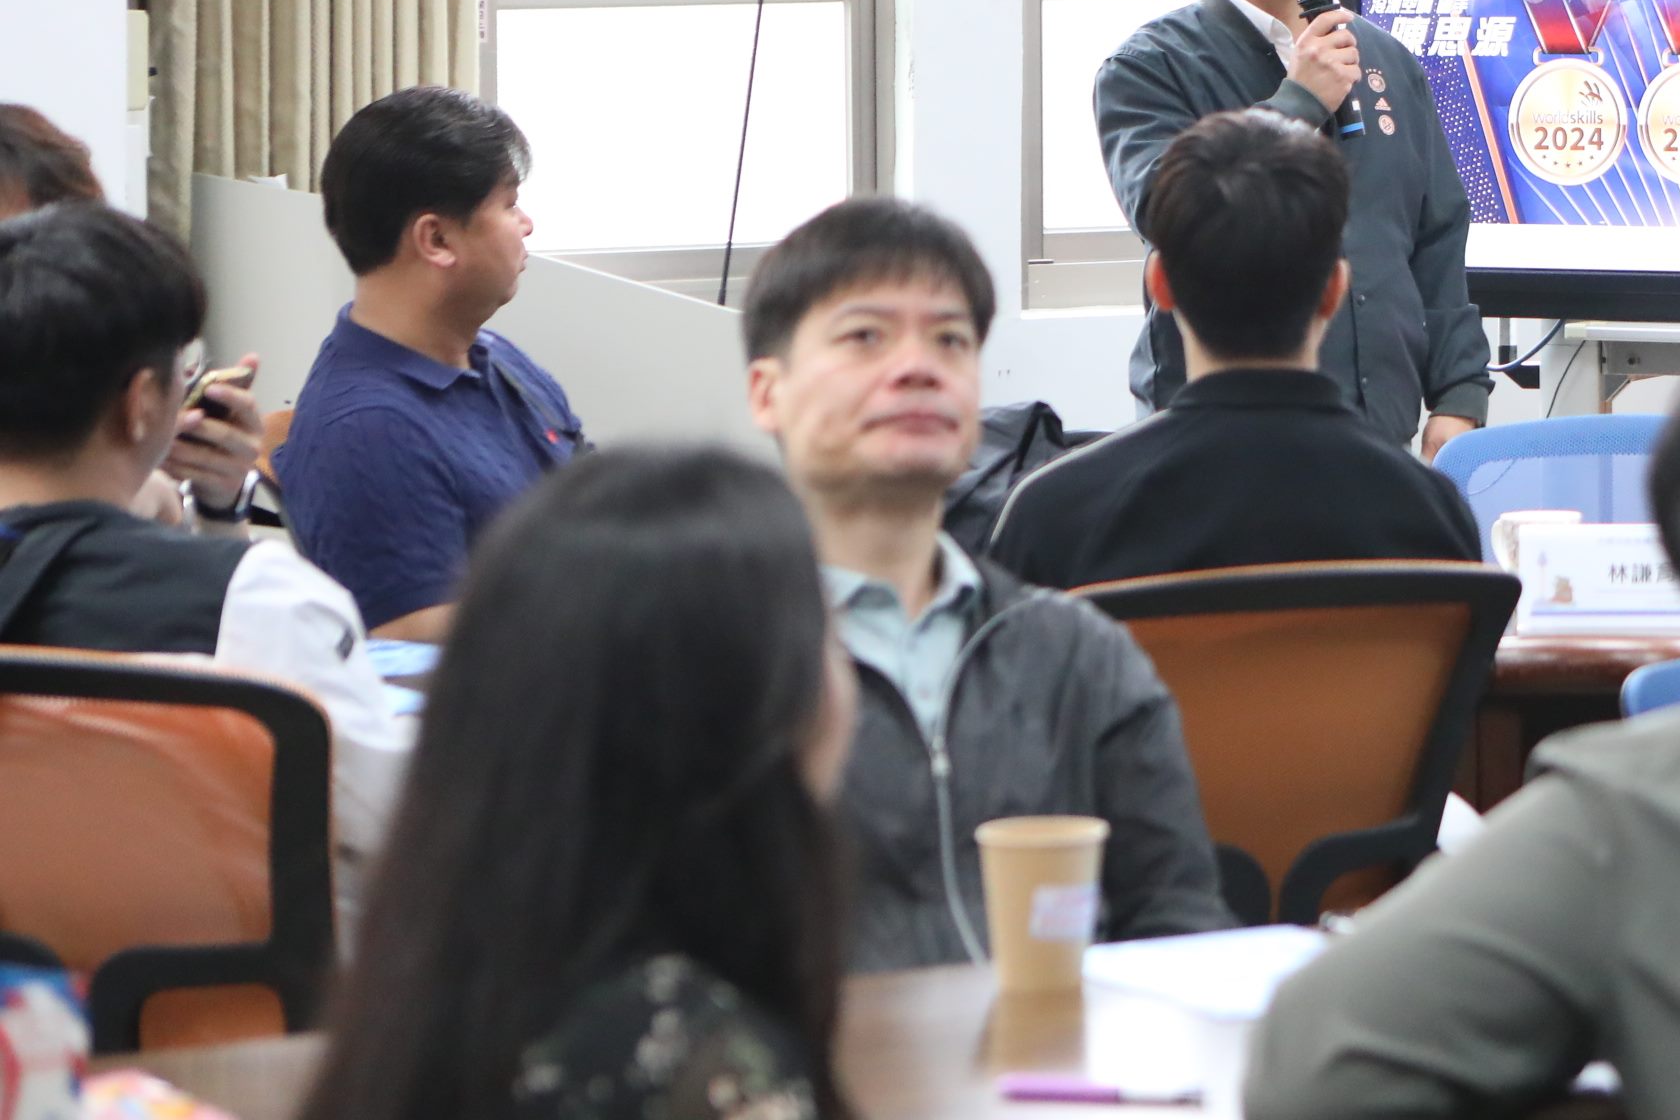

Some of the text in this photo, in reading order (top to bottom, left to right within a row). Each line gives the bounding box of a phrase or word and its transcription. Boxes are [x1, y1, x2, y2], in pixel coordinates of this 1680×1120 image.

[1390, 16, 1517, 57] 陳思源
[1532, 109, 1604, 126] worldskills
[1533, 126, 1605, 151] 2024
